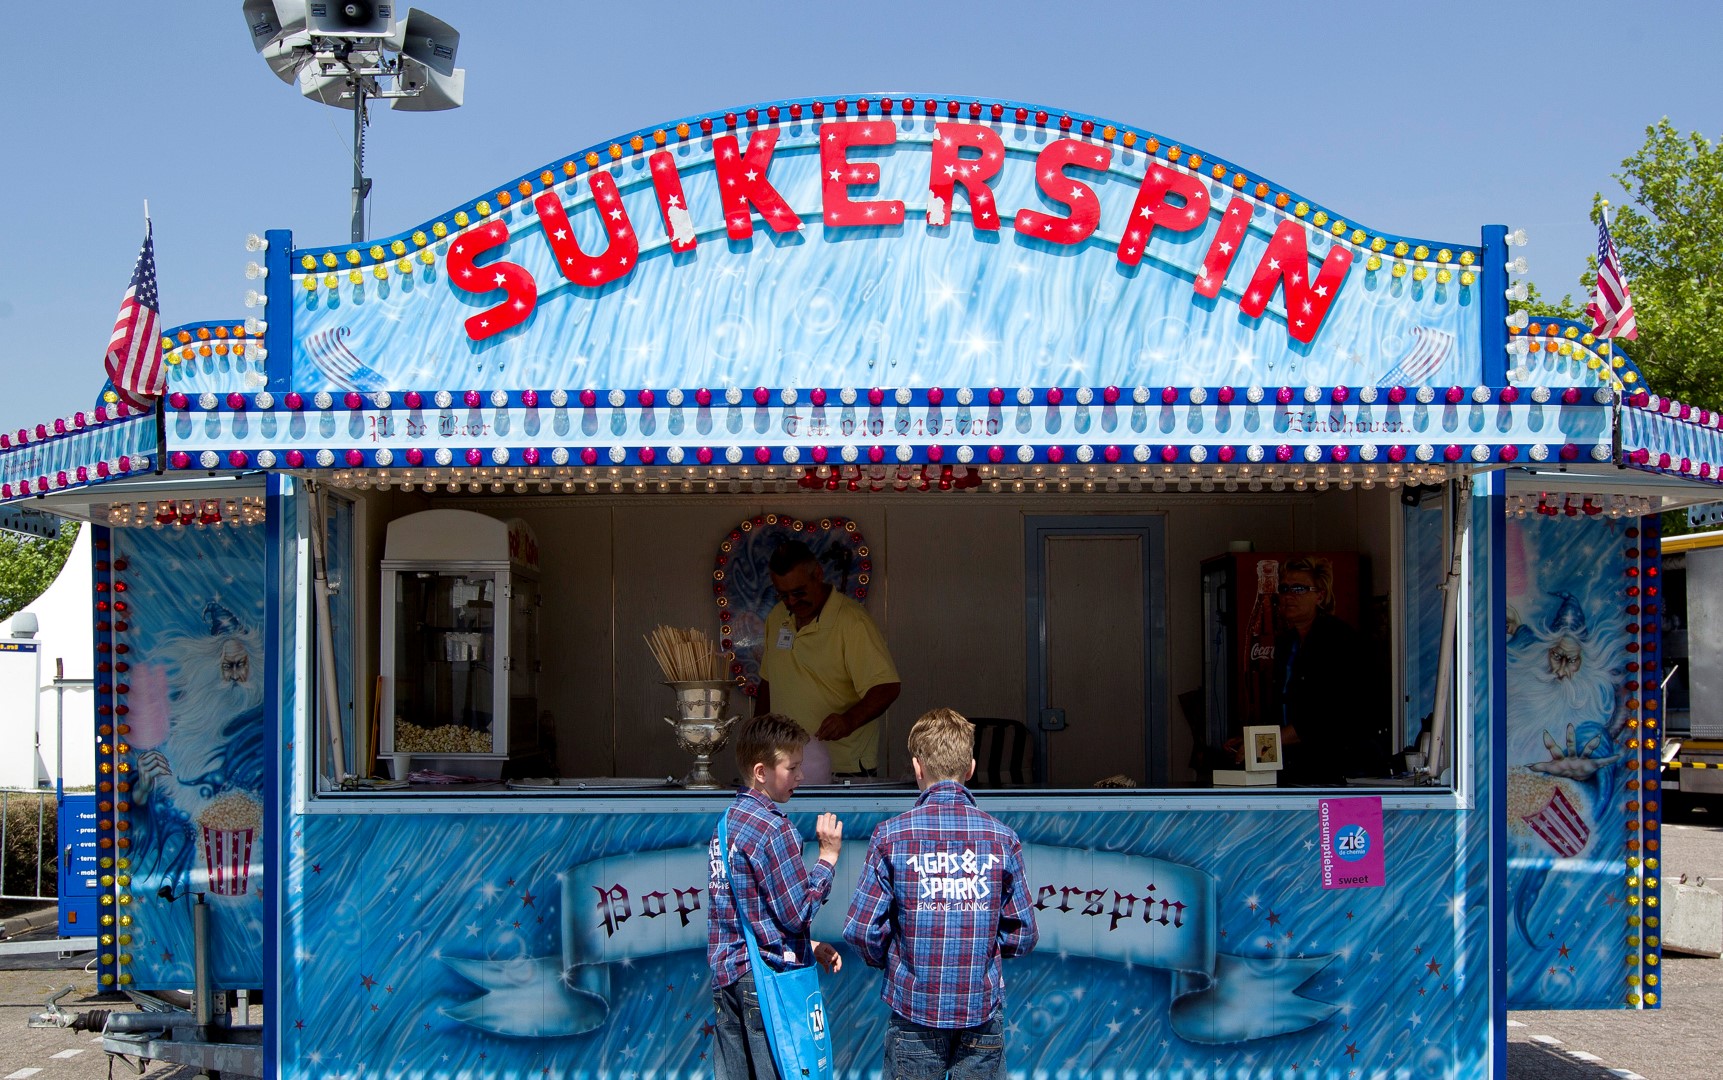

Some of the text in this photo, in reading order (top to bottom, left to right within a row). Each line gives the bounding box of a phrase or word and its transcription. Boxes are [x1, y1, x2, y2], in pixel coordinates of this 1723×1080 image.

[446, 119, 1353, 344] SUIKERSPIN
[1320, 802, 1333, 886] consumptiebon
[920, 875, 990, 900] SPARKS
[1338, 875, 1369, 885] sweet
[917, 901, 989, 911] ENGINE TUNING
